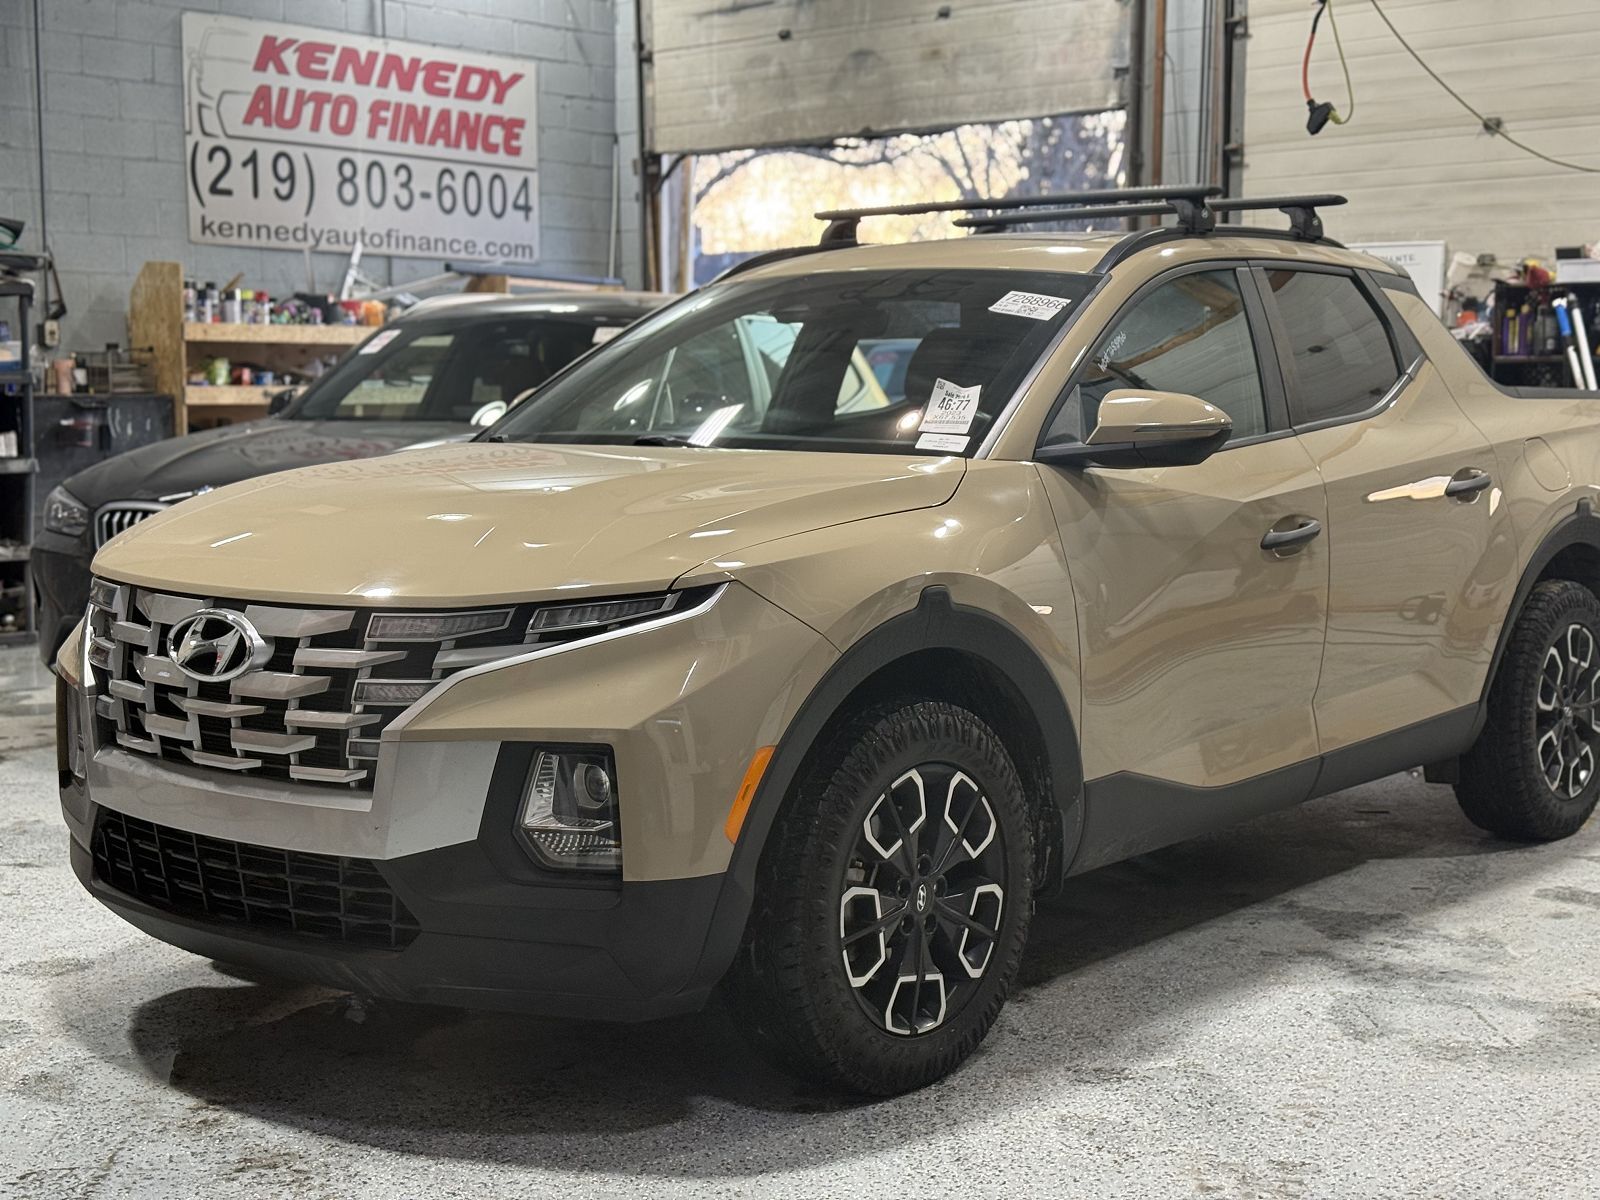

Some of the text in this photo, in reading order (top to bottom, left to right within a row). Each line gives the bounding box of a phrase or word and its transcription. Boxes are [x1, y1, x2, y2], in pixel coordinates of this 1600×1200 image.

[254, 35, 524, 104] KENNEDY
[243, 84, 526, 156] AUTO FINANCE
[190, 141, 533, 222] (219) 803-6004
[201, 215, 534, 259] kennedyautofinance.com
[937, 397, 971, 411] 46:77
